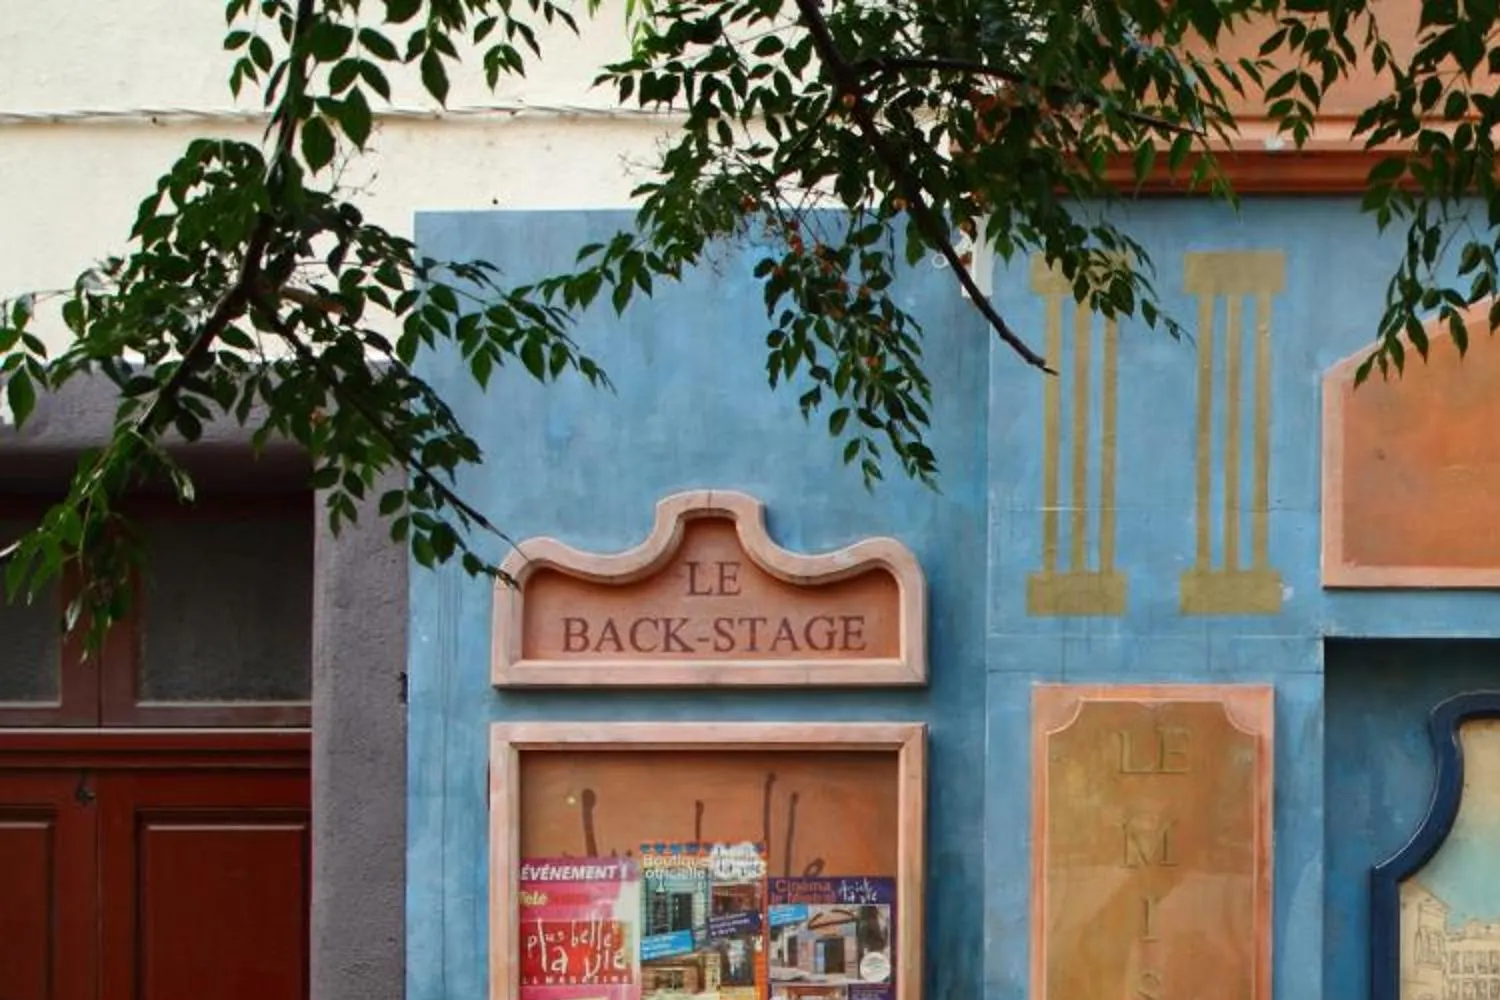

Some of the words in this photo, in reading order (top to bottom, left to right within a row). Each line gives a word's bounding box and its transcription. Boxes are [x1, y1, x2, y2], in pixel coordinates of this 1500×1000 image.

[685, 560, 742, 597] LE
[560, 615, 867, 654] BACK-STAGE
[1117, 726, 1193, 776] LE
[520, 863, 617, 881] ÉVÉNEMENT
[571, 911, 613, 950] belle
[584, 946, 627, 978] vie
